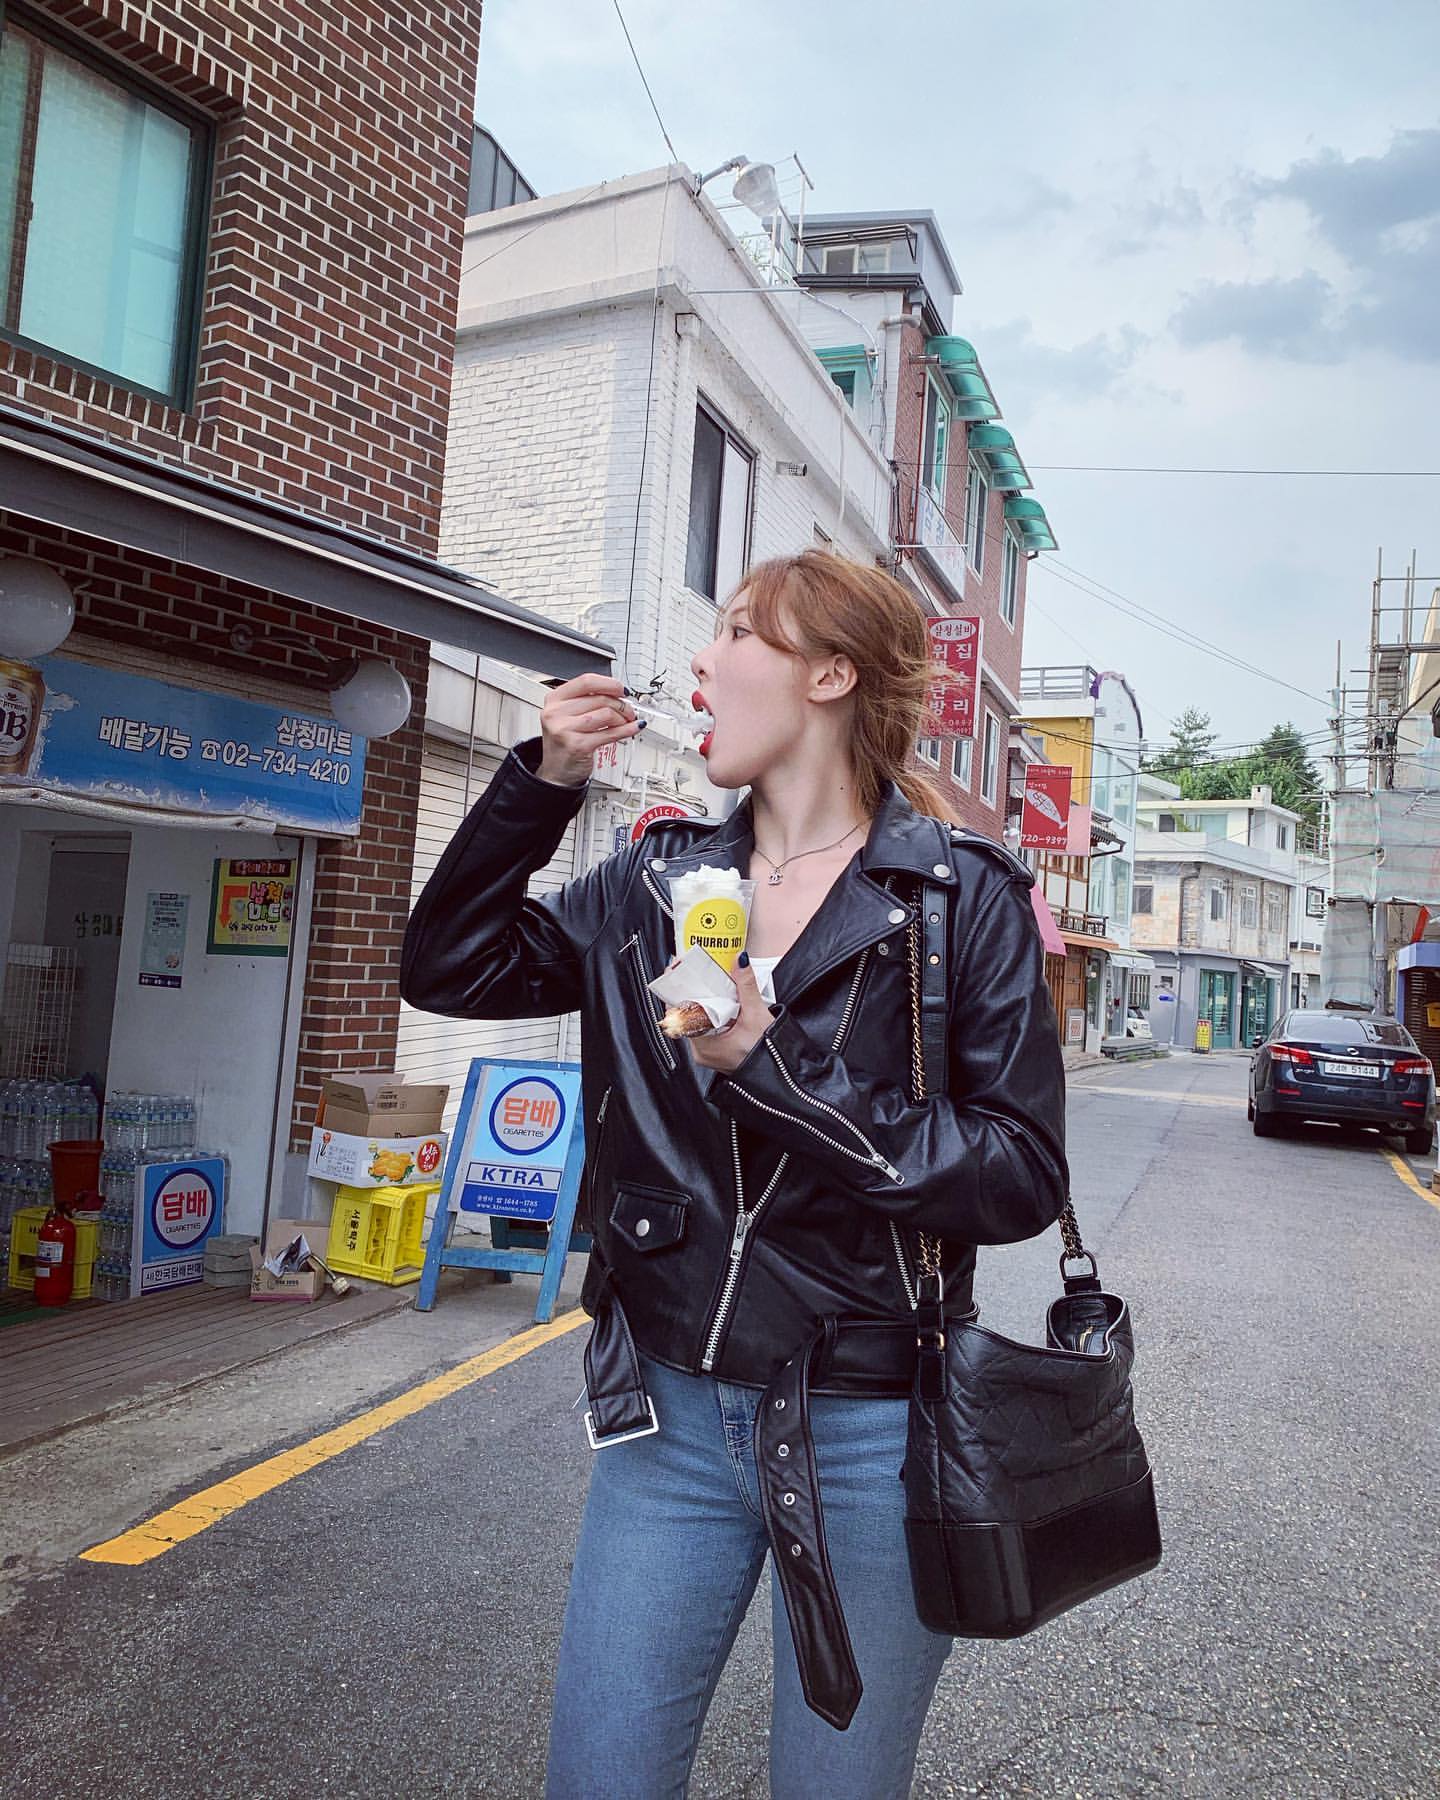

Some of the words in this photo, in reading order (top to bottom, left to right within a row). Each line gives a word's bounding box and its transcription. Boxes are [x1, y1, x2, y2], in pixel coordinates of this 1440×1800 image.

[276, 715, 353, 756] 삼청마트
[98, 716, 193, 760] 배달가능
[221, 740, 351, 786] 02-734-4210
[690, 935, 729, 949] CHURRO
[731, 936, 742, 948] 101
[1351, 1065, 1376, 1076] 5144
[503, 1097, 557, 1129] 담배
[503, 1127, 544, 1138] CIGARETTES
[481, 1166, 545, 1187] KTRA
[162, 1189, 208, 1221] 담배
